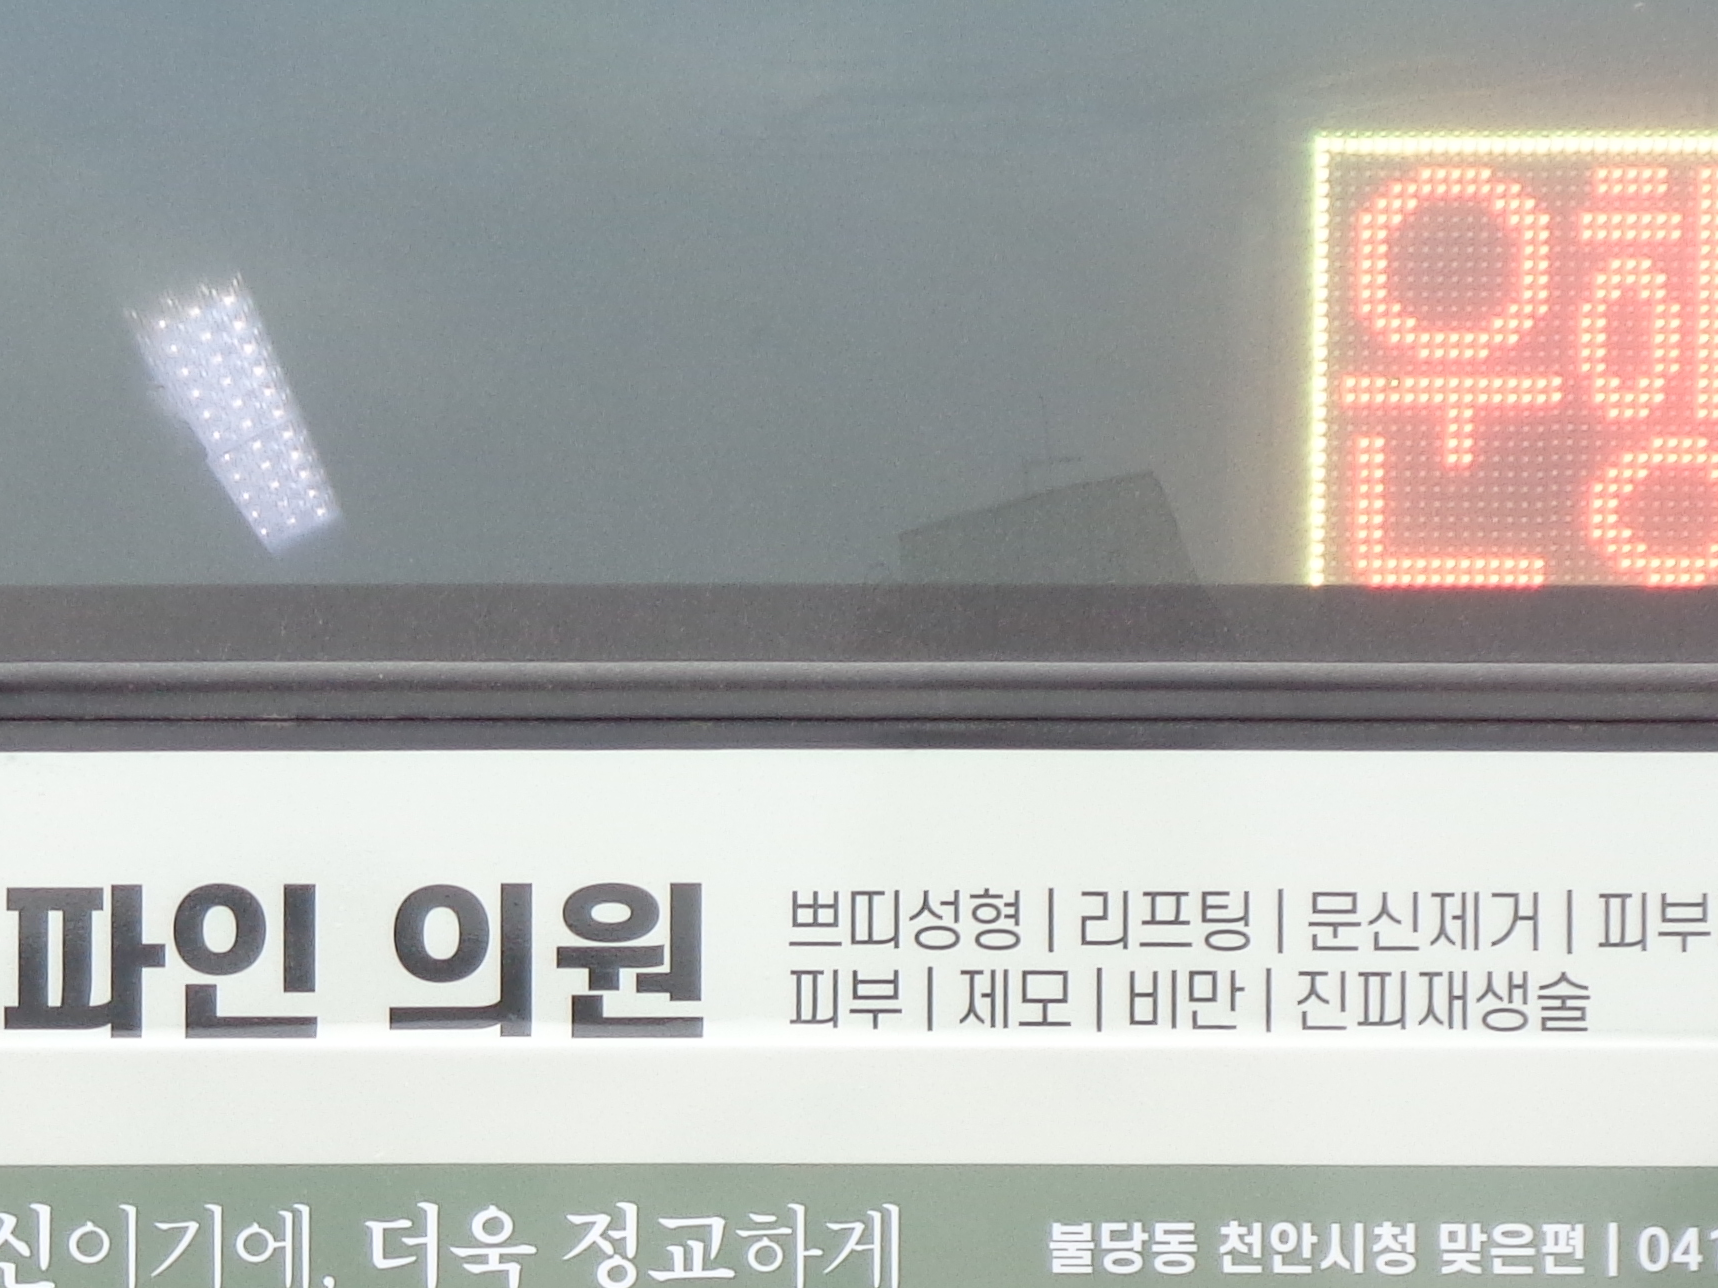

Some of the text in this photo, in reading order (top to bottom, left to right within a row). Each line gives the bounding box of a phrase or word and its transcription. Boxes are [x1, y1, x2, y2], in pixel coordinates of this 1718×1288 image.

[787, 886, 1025, 954] 쁘띠성형
[1079, 888, 1255, 954] 리프팅
[1307, 890, 1543, 954] 문신제거
[387, 882, 705, 1041] 의원
[787, 966, 1592, 1032] 피부 제모 비만 진피재생술
[1048, 1222, 1197, 1276] 불당동
[1219, 1222, 1419, 1276] 천안시청
[1439, 1222, 1586, 1276] 맞은편
